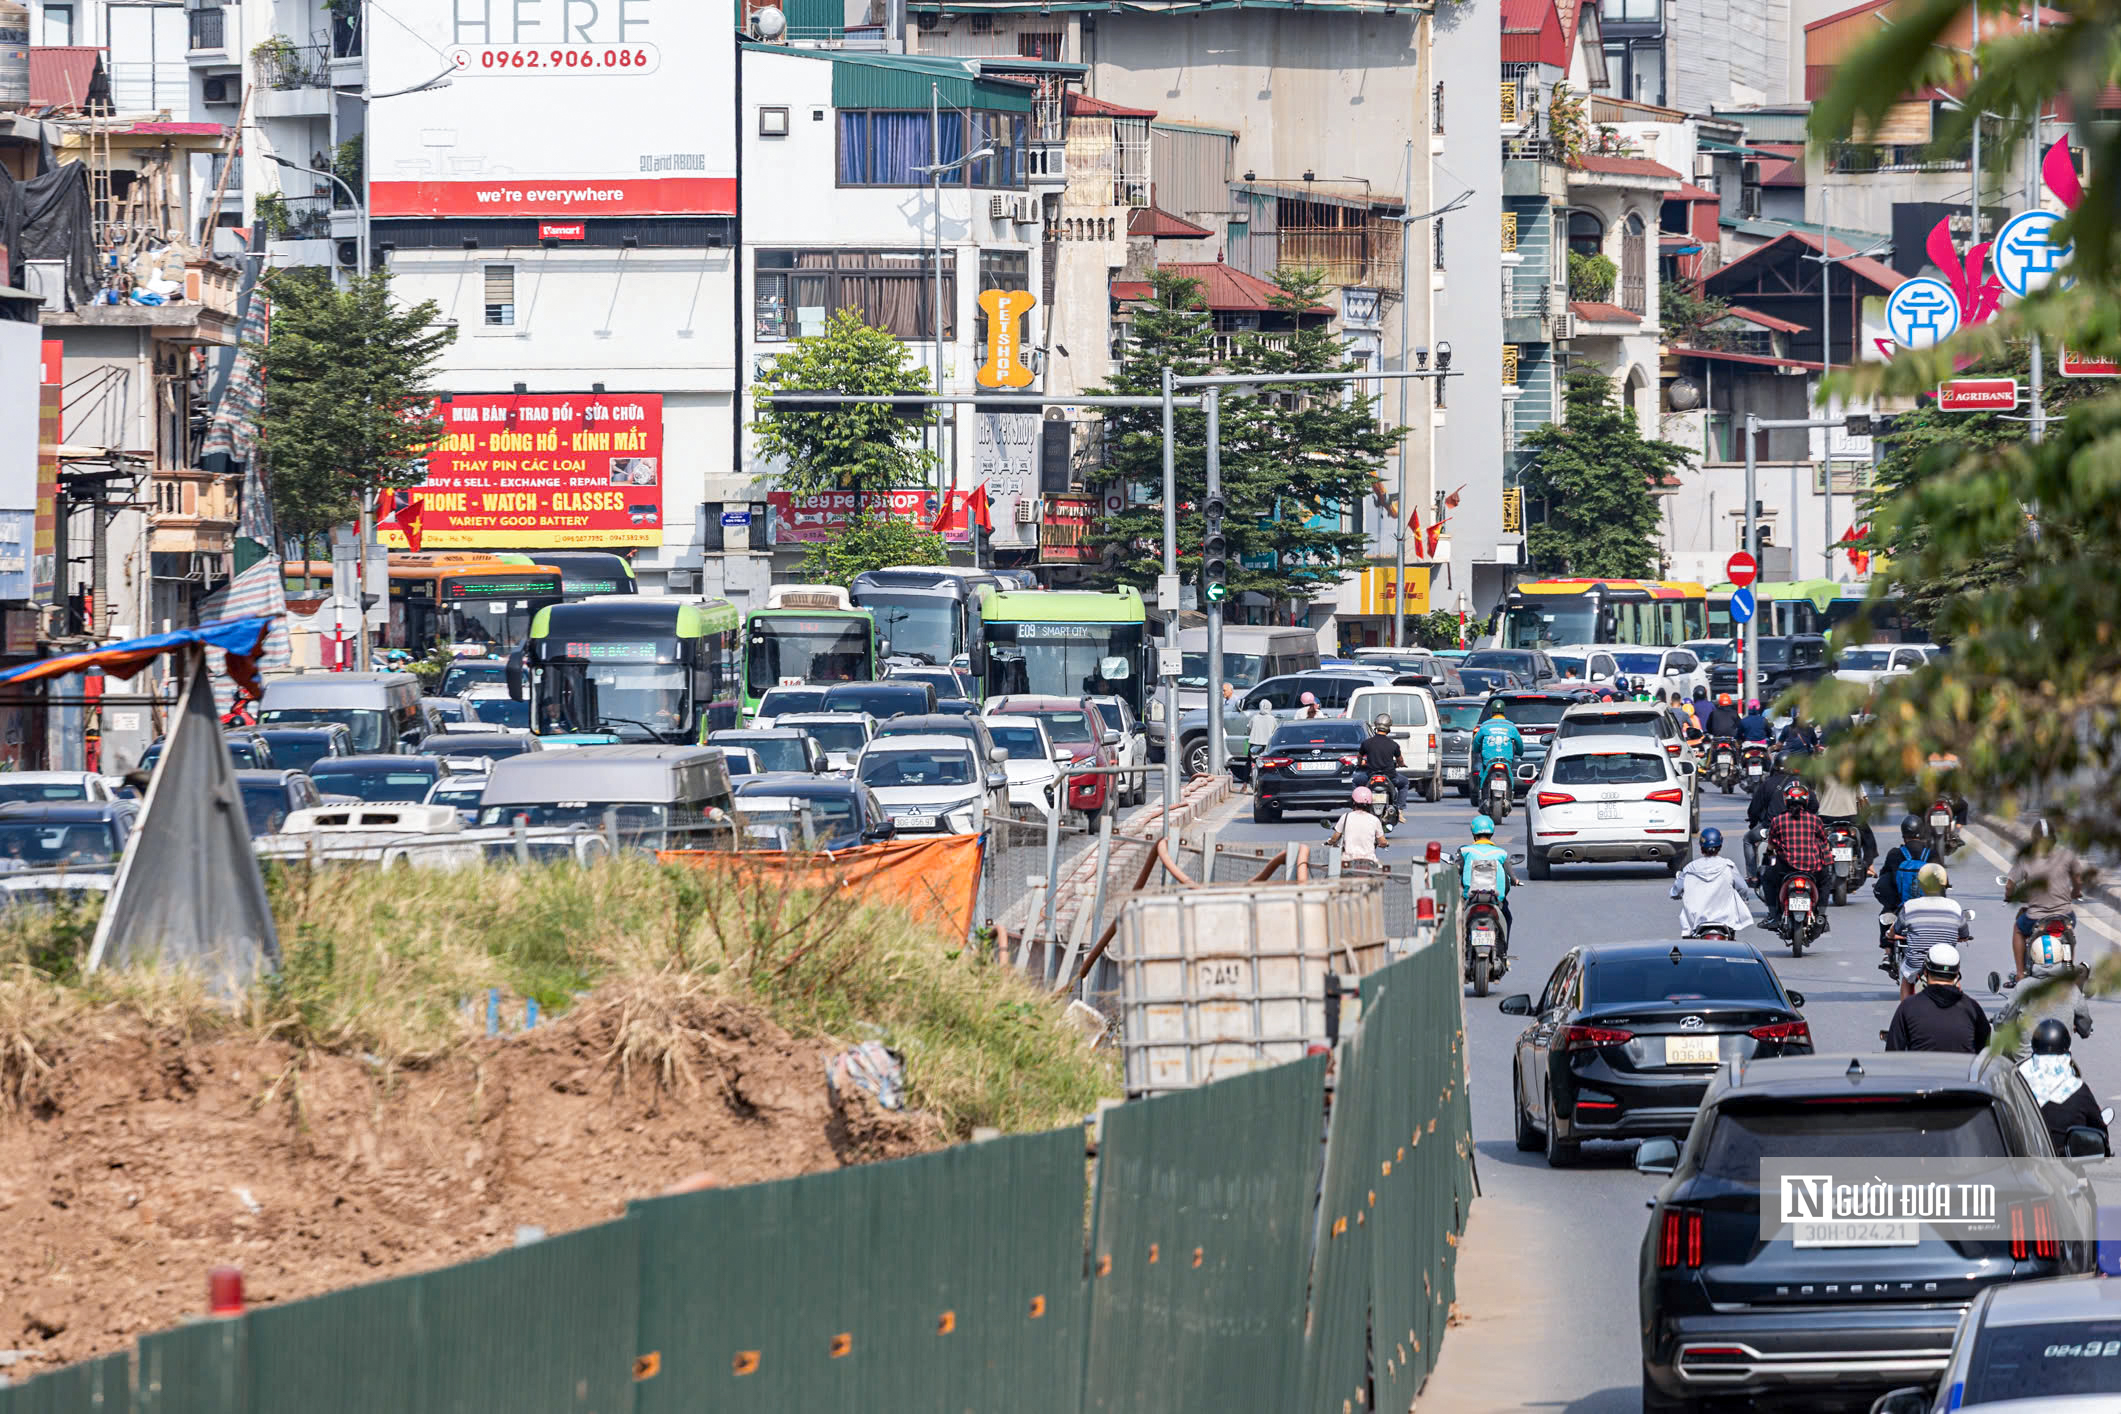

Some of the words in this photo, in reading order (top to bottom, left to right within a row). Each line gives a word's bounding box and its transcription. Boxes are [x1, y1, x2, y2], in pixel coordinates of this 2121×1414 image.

[481, 50, 647, 68] 0962.906.086
[526, 187, 624, 204] everywhere
[1955, 391, 2013, 401] AGRIBANK
[452, 407, 479, 422] MUA
[482, 404, 507, 421] BÁN
[519, 407, 549, 421] TRAO
[552, 402, 573, 421] ĐỔI
[585, 402, 609, 420] SỬA
[612, 404, 644, 420] CHỮA
[433, 433, 475, 455] HOẠI
[490, 427, 532, 451] ĐỒNG
[537, 427, 558, 451] HỒ
[572, 429, 610, 451] KÍNH
[614, 426, 647, 451] MẮT
[452, 460, 488, 472] THAY
[493, 459, 517, 472] PIN
[521, 457, 549, 471] CÁC
[553, 459, 585, 473] LOẠI
[429, 478, 450, 487] BUY
[453, 478, 461, 487] &
[464, 478, 491, 487] SELL
[501, 478, 560, 487] EXCHANGE
[569, 477, 608, 486] REPAIR
[413, 493, 467, 512] PHONE
[483, 493, 537, 511] WATCH
[552, 492, 624, 511] GLASSES
[449, 517, 496, 526] VARIETY
[500, 516, 536, 526] GOOD
[539, 516, 589, 526] BATTERY
[1386, 582, 1418, 599] DL
[1019, 624, 1036, 637] E09
[1041, 626, 1070, 637] SMART
[1071, 627, 1088, 637] CITY
[1776, 1282, 1937, 1296] SORENTO
